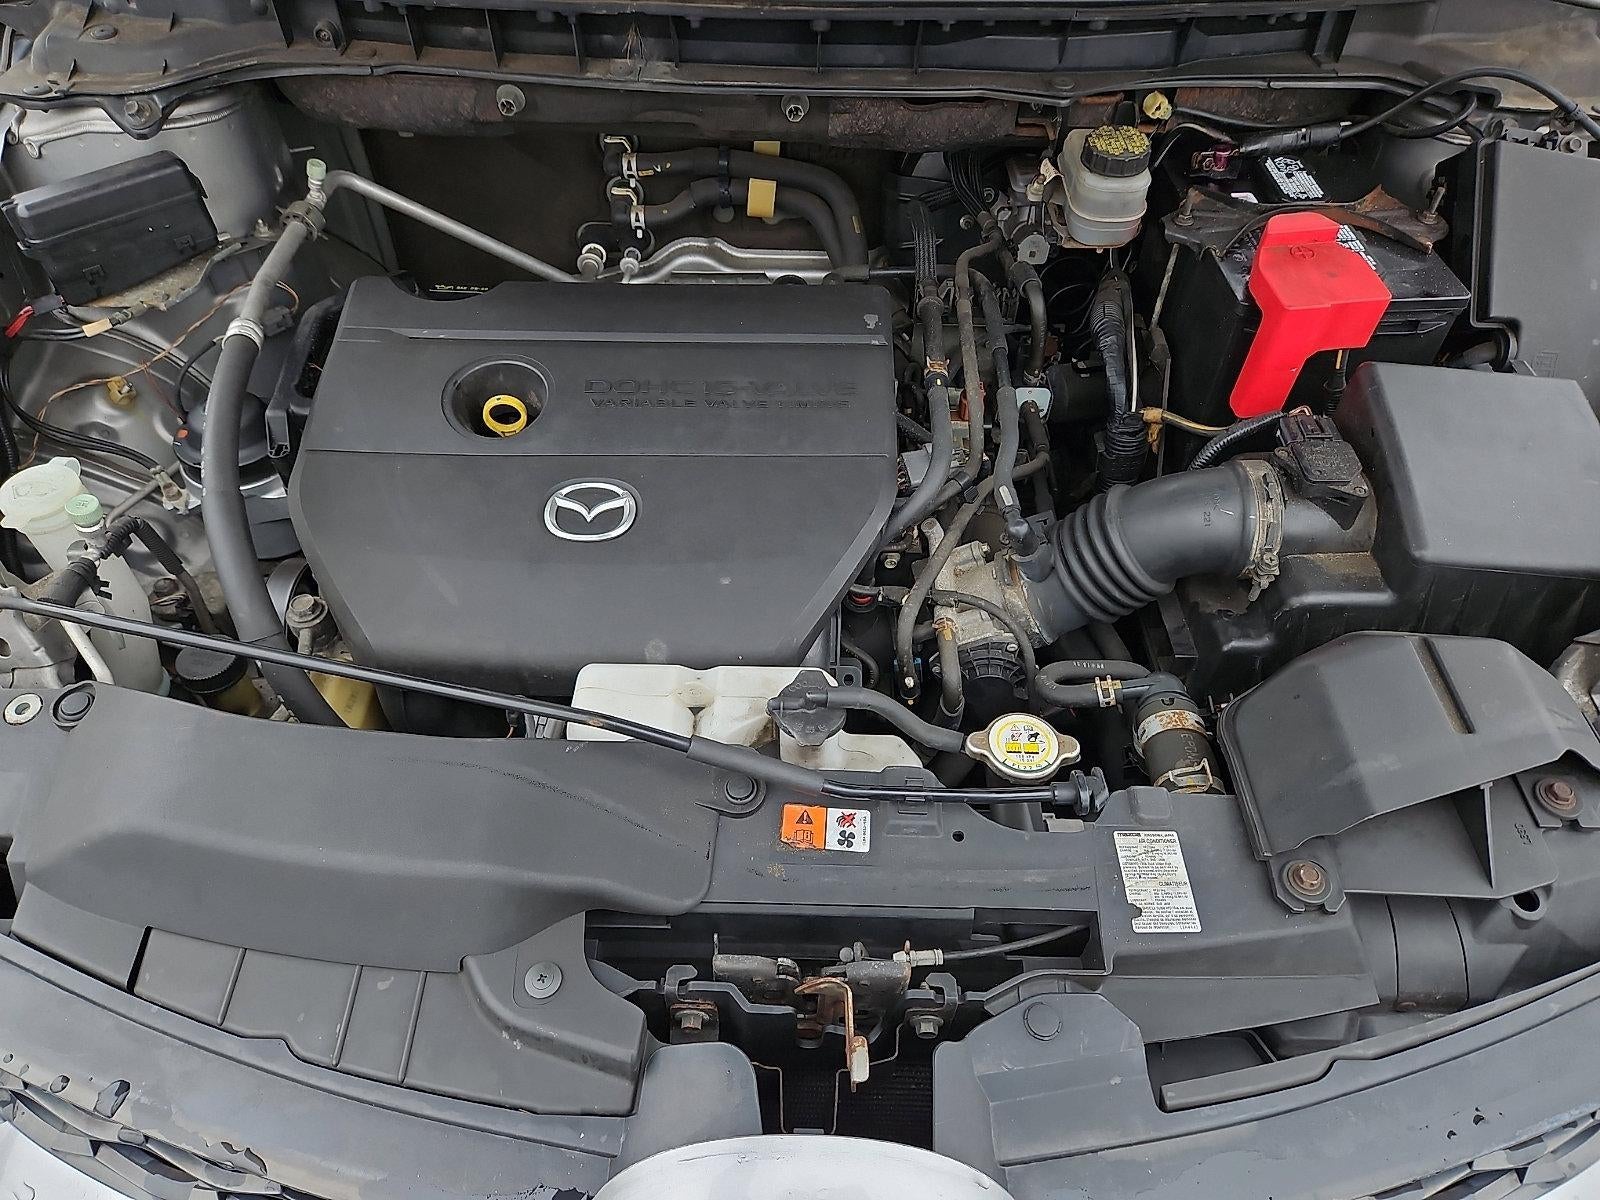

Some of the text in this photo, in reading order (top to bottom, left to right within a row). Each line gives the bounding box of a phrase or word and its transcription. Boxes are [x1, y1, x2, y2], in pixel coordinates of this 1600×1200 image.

[584, 379, 697, 395] DOHC
[590, 398, 697, 409] VARIABLE
[704, 399, 769, 409] VALVE
